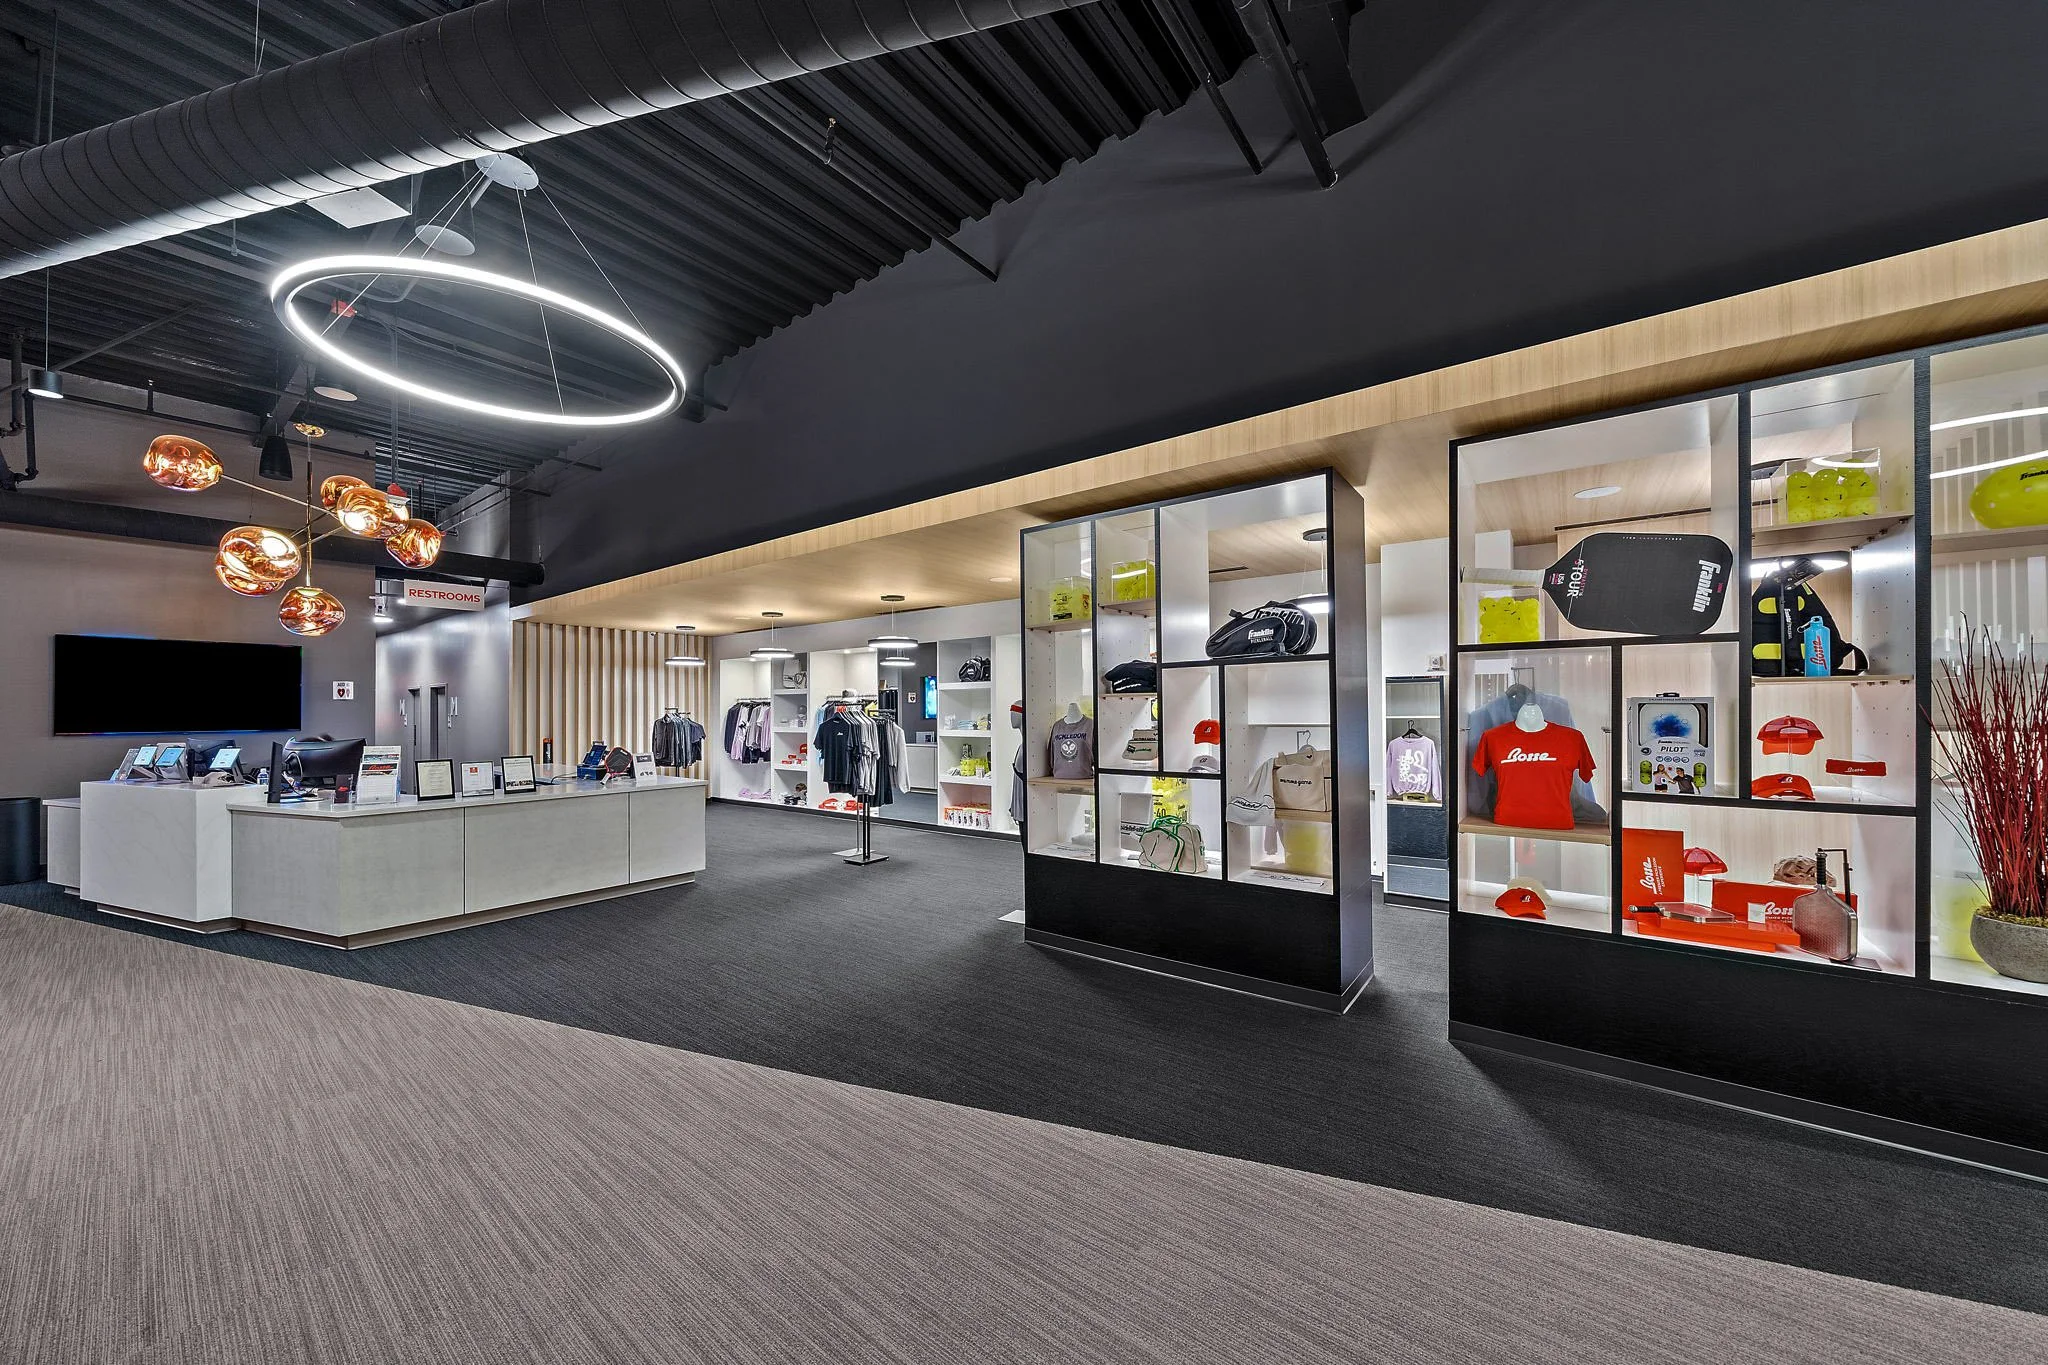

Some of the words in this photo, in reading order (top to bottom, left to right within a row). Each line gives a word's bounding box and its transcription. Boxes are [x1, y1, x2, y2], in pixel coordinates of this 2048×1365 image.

[408, 588, 481, 603] RESTROOMS
[1500, 747, 1558, 764] Bosse
[1640, 856, 1658, 895] Bosse
[1765, 901, 1794, 916] Boss
